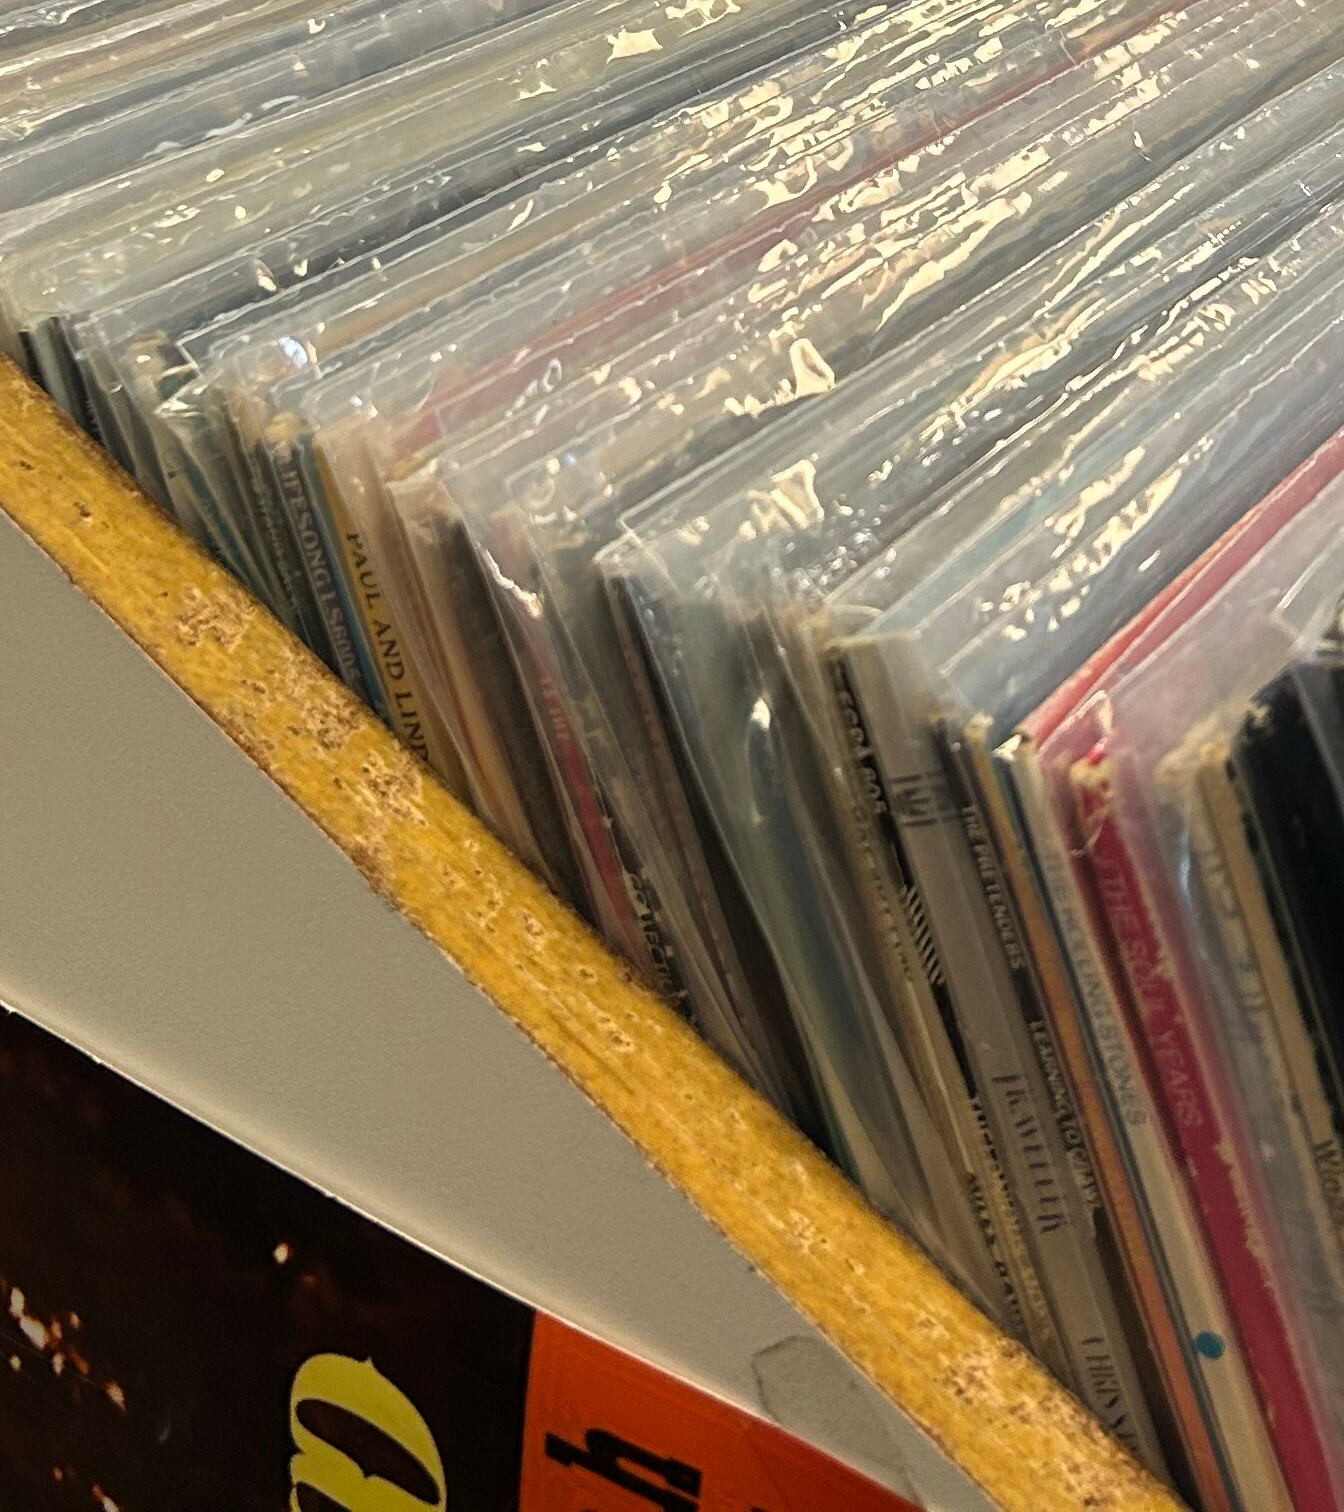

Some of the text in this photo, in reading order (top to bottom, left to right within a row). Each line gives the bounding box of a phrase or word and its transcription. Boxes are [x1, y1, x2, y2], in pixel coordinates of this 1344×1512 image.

[275, 452, 329, 593] LIFESONG
[347, 531, 382, 608] PAUL
[374, 617, 405, 682] AND
